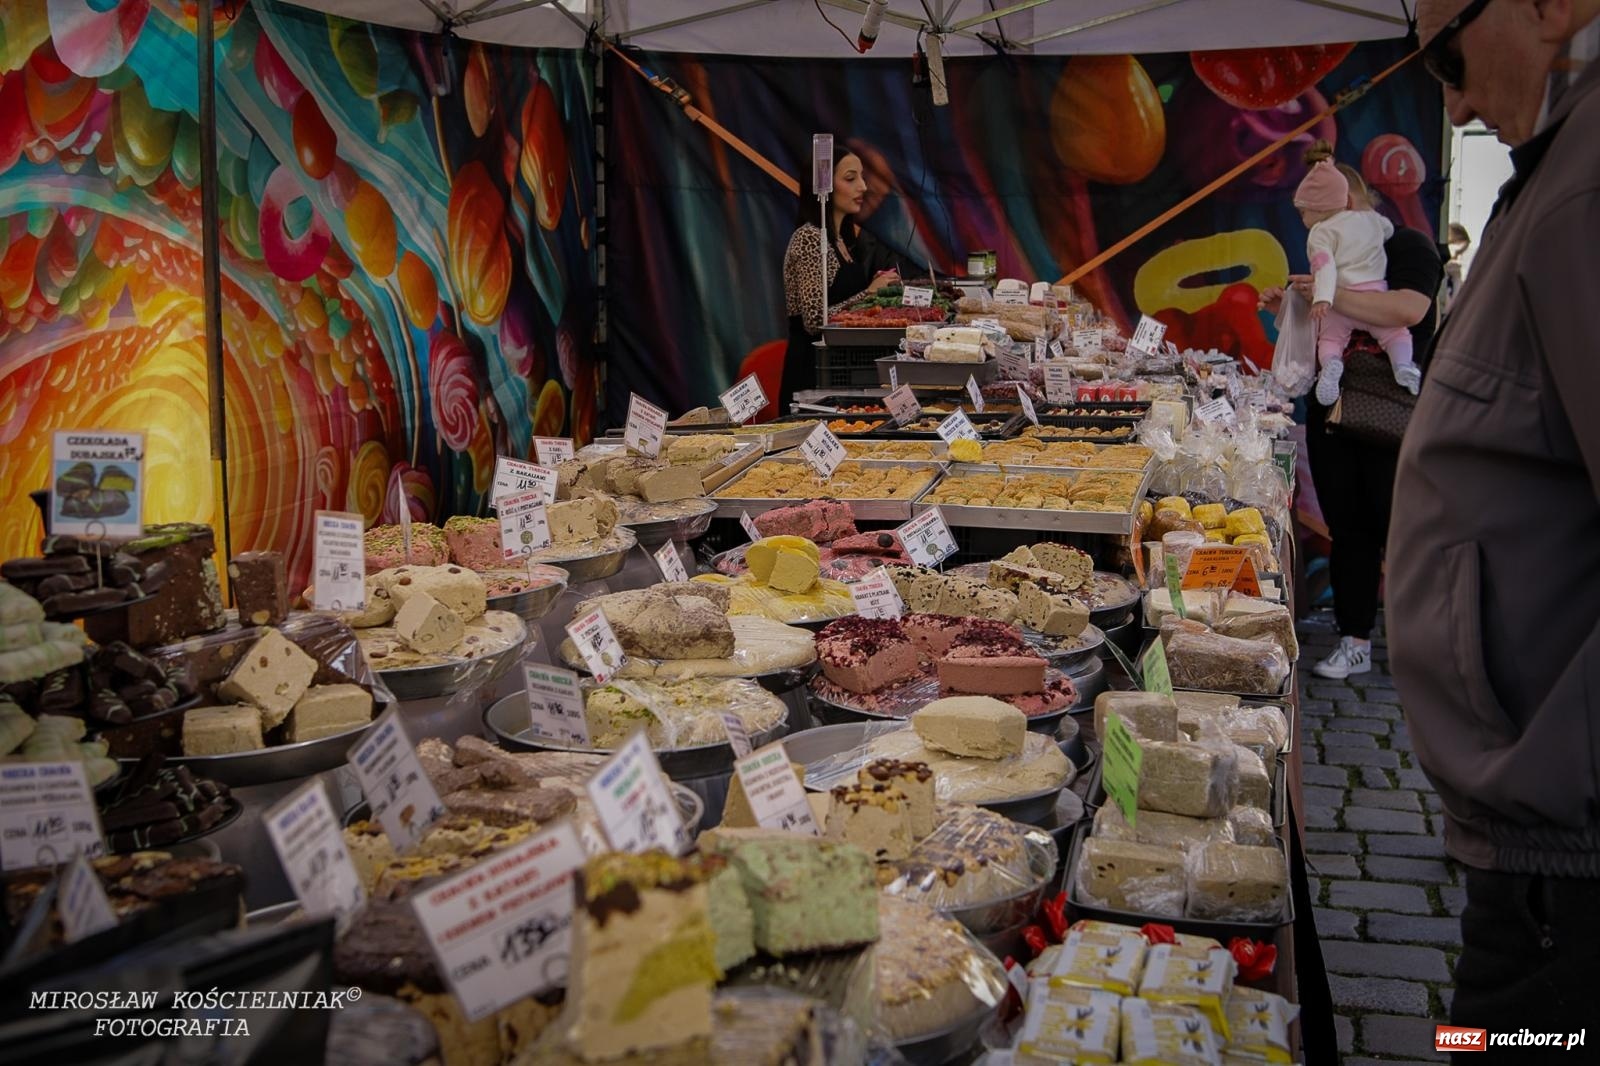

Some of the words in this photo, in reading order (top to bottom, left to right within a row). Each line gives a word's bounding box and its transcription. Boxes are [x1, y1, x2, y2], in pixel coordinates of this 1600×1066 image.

[67, 436, 128, 446] CZEKOLADA
[824, 430, 840, 450] BAKLAWA
[70, 450, 124, 459] DUBAJSKA
[529, 465, 550, 475] TURECKA
[453, 955, 491, 981] CENA
